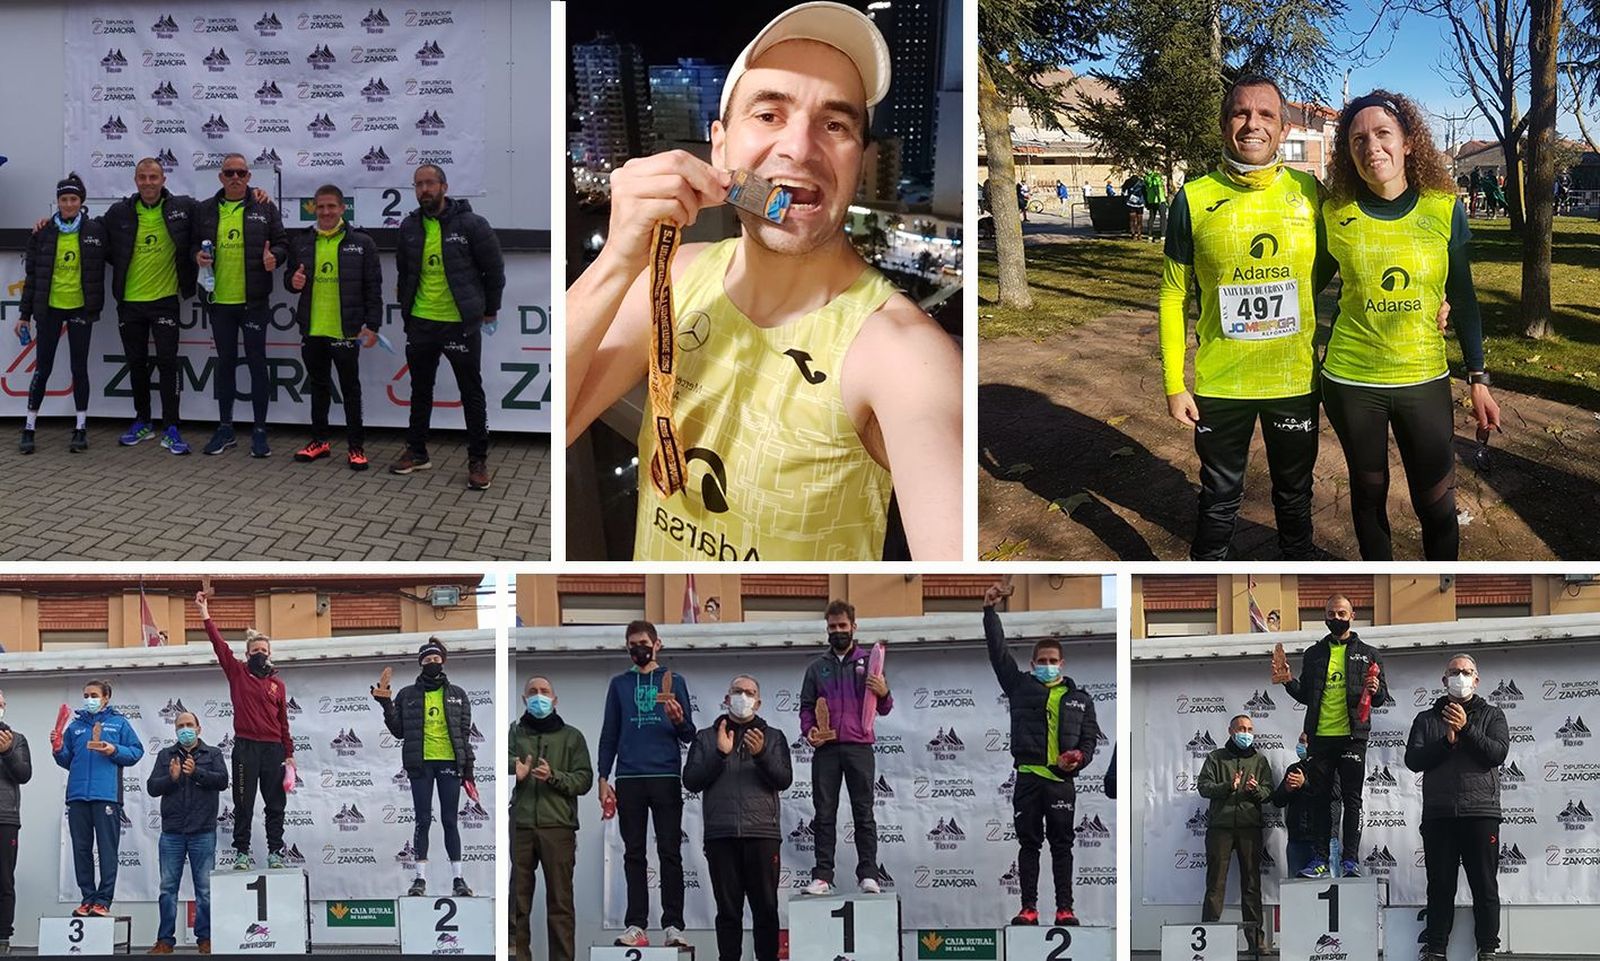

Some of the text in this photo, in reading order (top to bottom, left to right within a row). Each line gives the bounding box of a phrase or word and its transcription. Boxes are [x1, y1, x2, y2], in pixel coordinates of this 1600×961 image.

[418, 17, 453, 26] ZAMORA
[103, 26, 136, 34] ZAMORA
[206, 25, 239, 33] ZAMORA
[154, 59, 187, 67] ZAMORA
[258, 58, 291, 66] ZAMORA
[419, 87, 454, 95] ZAMORA
[104, 93, 136, 101] ZAMORA
[205, 92, 238, 100] ZAMORA
[154, 126, 187, 134] ZAMORA
[257, 125, 291, 133] ZAMORA
[364, 123, 399, 131] ZAMORA
[103, 160, 136, 168] ZAMORA
[382, 189, 401, 216] 2
[1233, 266, 1290, 281] Adarsa
[1237, 294, 1283, 320] 497
[1364, 298, 1423, 313] Adarsa
[1559, 689, 1600, 700] ZAMORA
[931, 699, 975, 708] ZAMORA
[333, 704, 371, 713] ZAMORA
[1189, 705, 1227, 713] ZAMORA
[1368, 740, 1406, 749] ZAMORA
[1563, 739, 1584, 747] Toro
[934, 752, 956, 760] Toro
[335, 778, 374, 788] ZAMORA
[931, 789, 976, 798] ZAMORA
[1367, 819, 1407, 827] ZAMORA
[1564, 823, 1585, 831] Toro
[934, 842, 957, 850] Toro
[337, 854, 376, 864] ZAMORA
[932, 878, 977, 888] ZAMORA
[246, 875, 268, 921] 1
[1317, 884, 1339, 932] 1
[434, 898, 459, 932] 2
[68, 918, 84, 943] 3
[831, 901, 855, 953] 1
[1191, 927, 1207, 951] 3
[1045, 927, 1073, 961] 2
